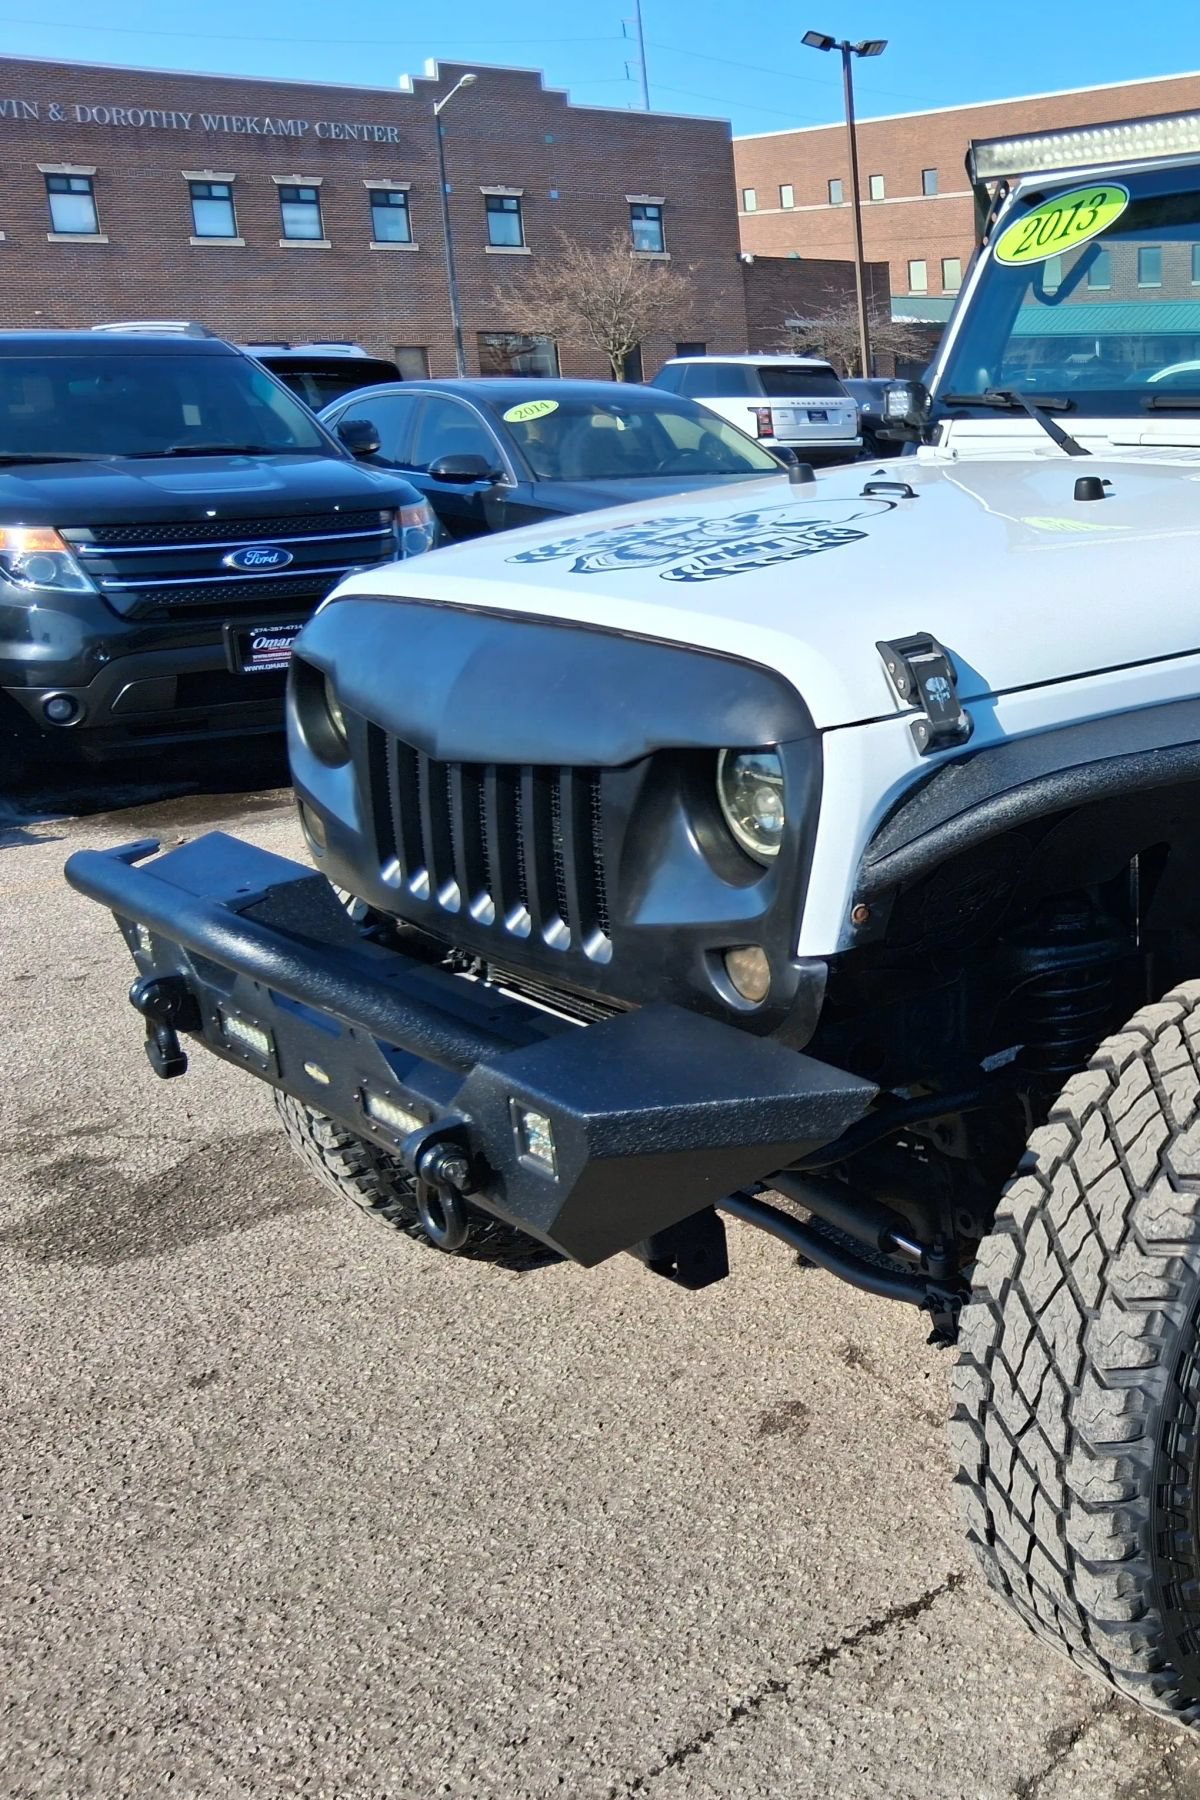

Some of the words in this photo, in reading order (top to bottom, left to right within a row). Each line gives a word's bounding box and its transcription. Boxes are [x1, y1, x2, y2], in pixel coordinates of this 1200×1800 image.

[49, 102, 67, 122] &
[73, 104, 192, 130] DOROTHY
[200, 113, 309, 137] WIEKAMP
[314, 121, 400, 143] CENTER
[1012, 192, 1107, 257] 2013
[514, 402, 550, 419] 2014
[243, 550, 279, 565] Ford
